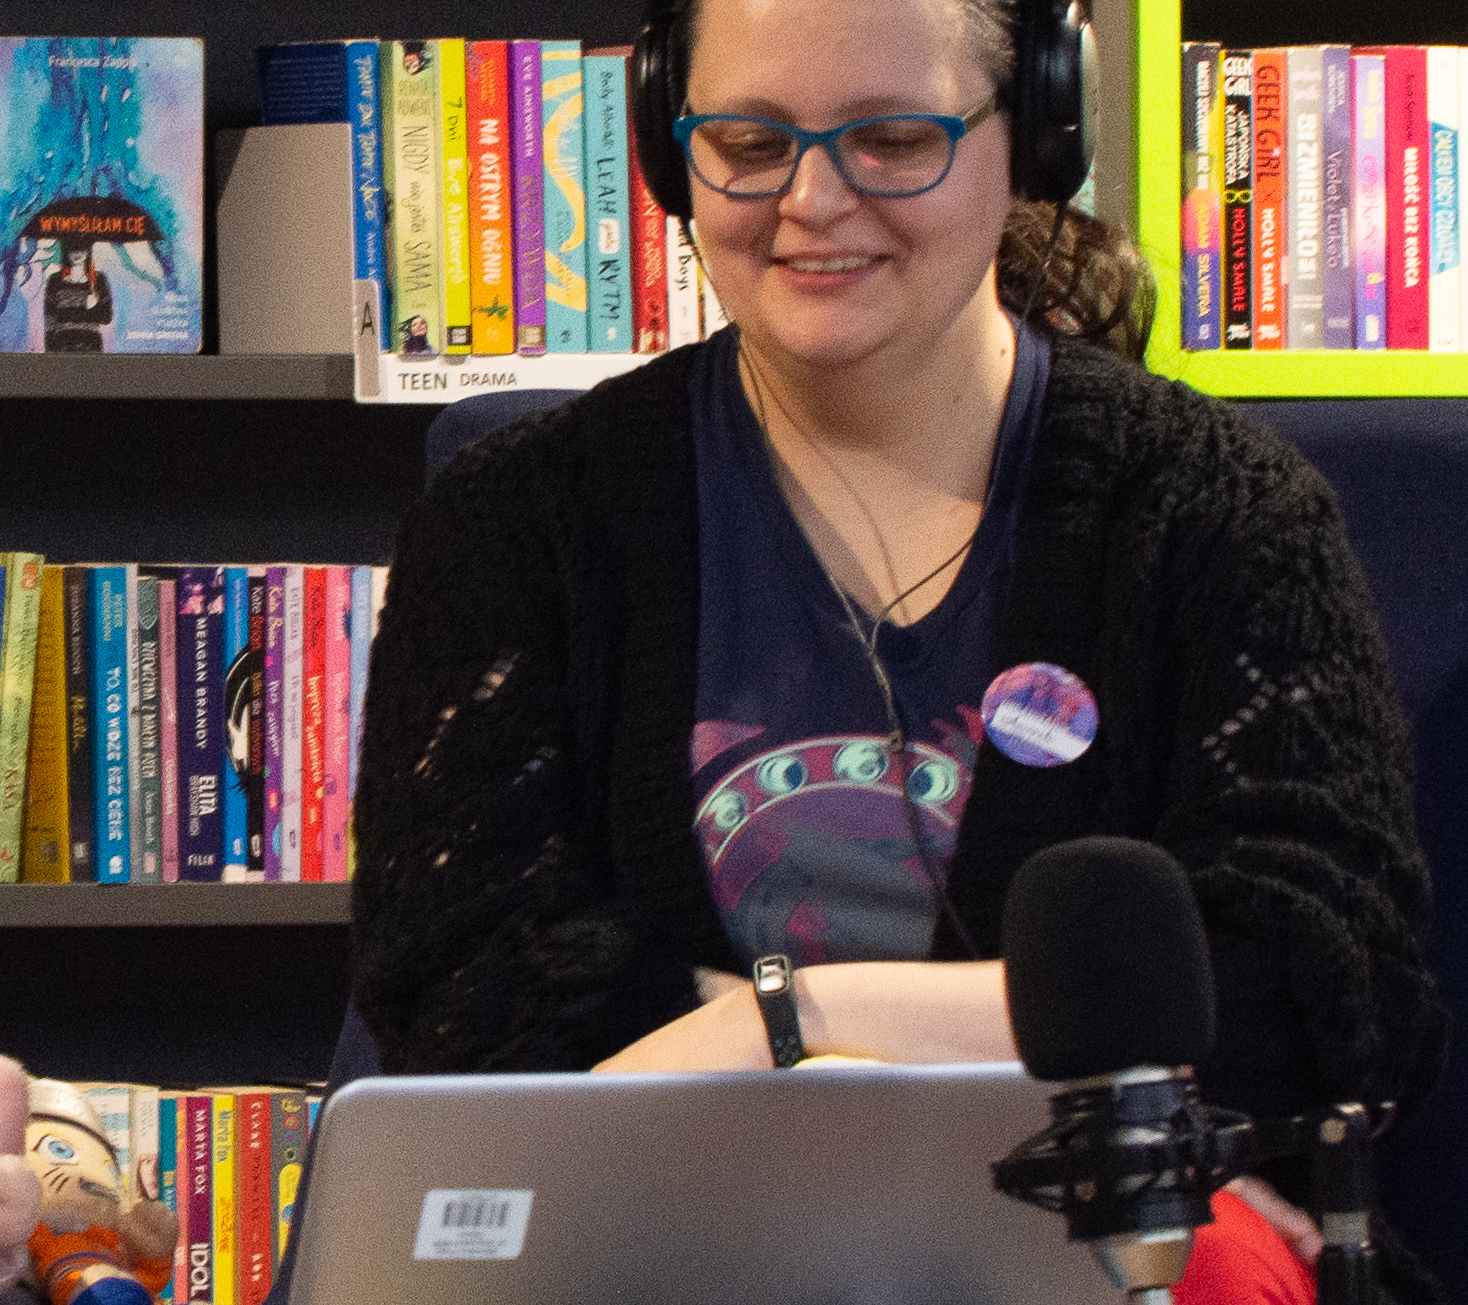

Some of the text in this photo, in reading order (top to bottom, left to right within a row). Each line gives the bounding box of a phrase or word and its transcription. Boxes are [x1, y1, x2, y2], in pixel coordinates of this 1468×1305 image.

[1257, 66, 1281, 122] GEEK
[480, 119, 499, 144] NA
[481, 153, 499, 219] OSTRYM
[398, 373, 516, 391] TEEN DRAMA
[198, 776, 217, 816] ELITA
[190, 1110, 208, 1295] MARTA FOX IDOL
